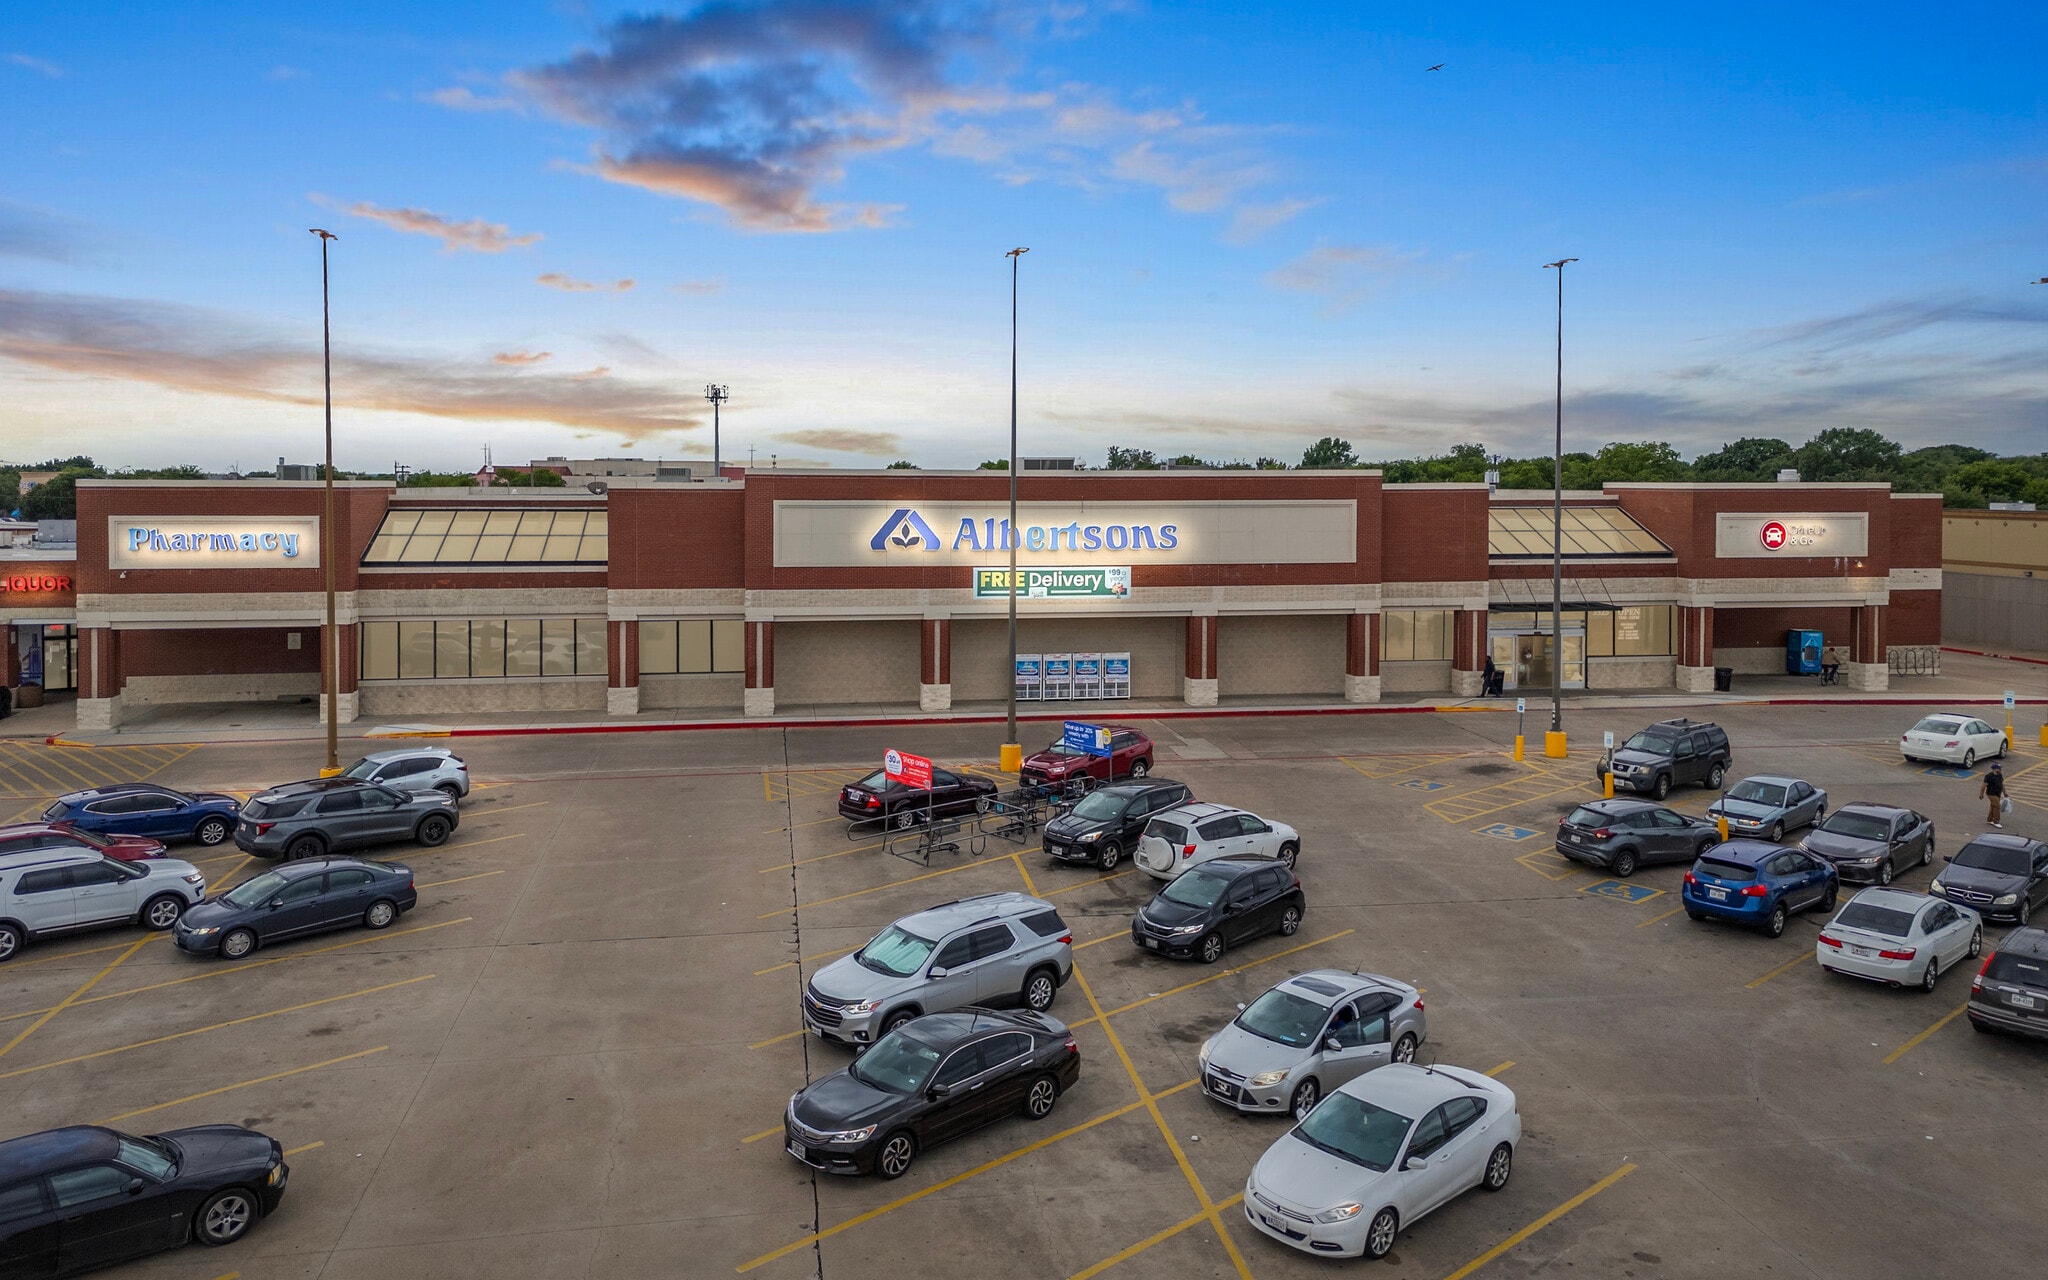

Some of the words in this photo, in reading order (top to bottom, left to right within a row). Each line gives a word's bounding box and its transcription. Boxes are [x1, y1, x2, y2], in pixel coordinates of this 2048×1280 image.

[128, 527, 299, 558] Pharmacy
[952, 517, 1178, 551] Albertsons
[1790, 536, 1798, 545] &
[1799, 536, 1815, 546] Go
[980, 571, 1026, 588] FREE
[1029, 571, 1103, 591] Delivery
[902, 756, 914, 766] Shop
[915, 759, 929, 768] online
